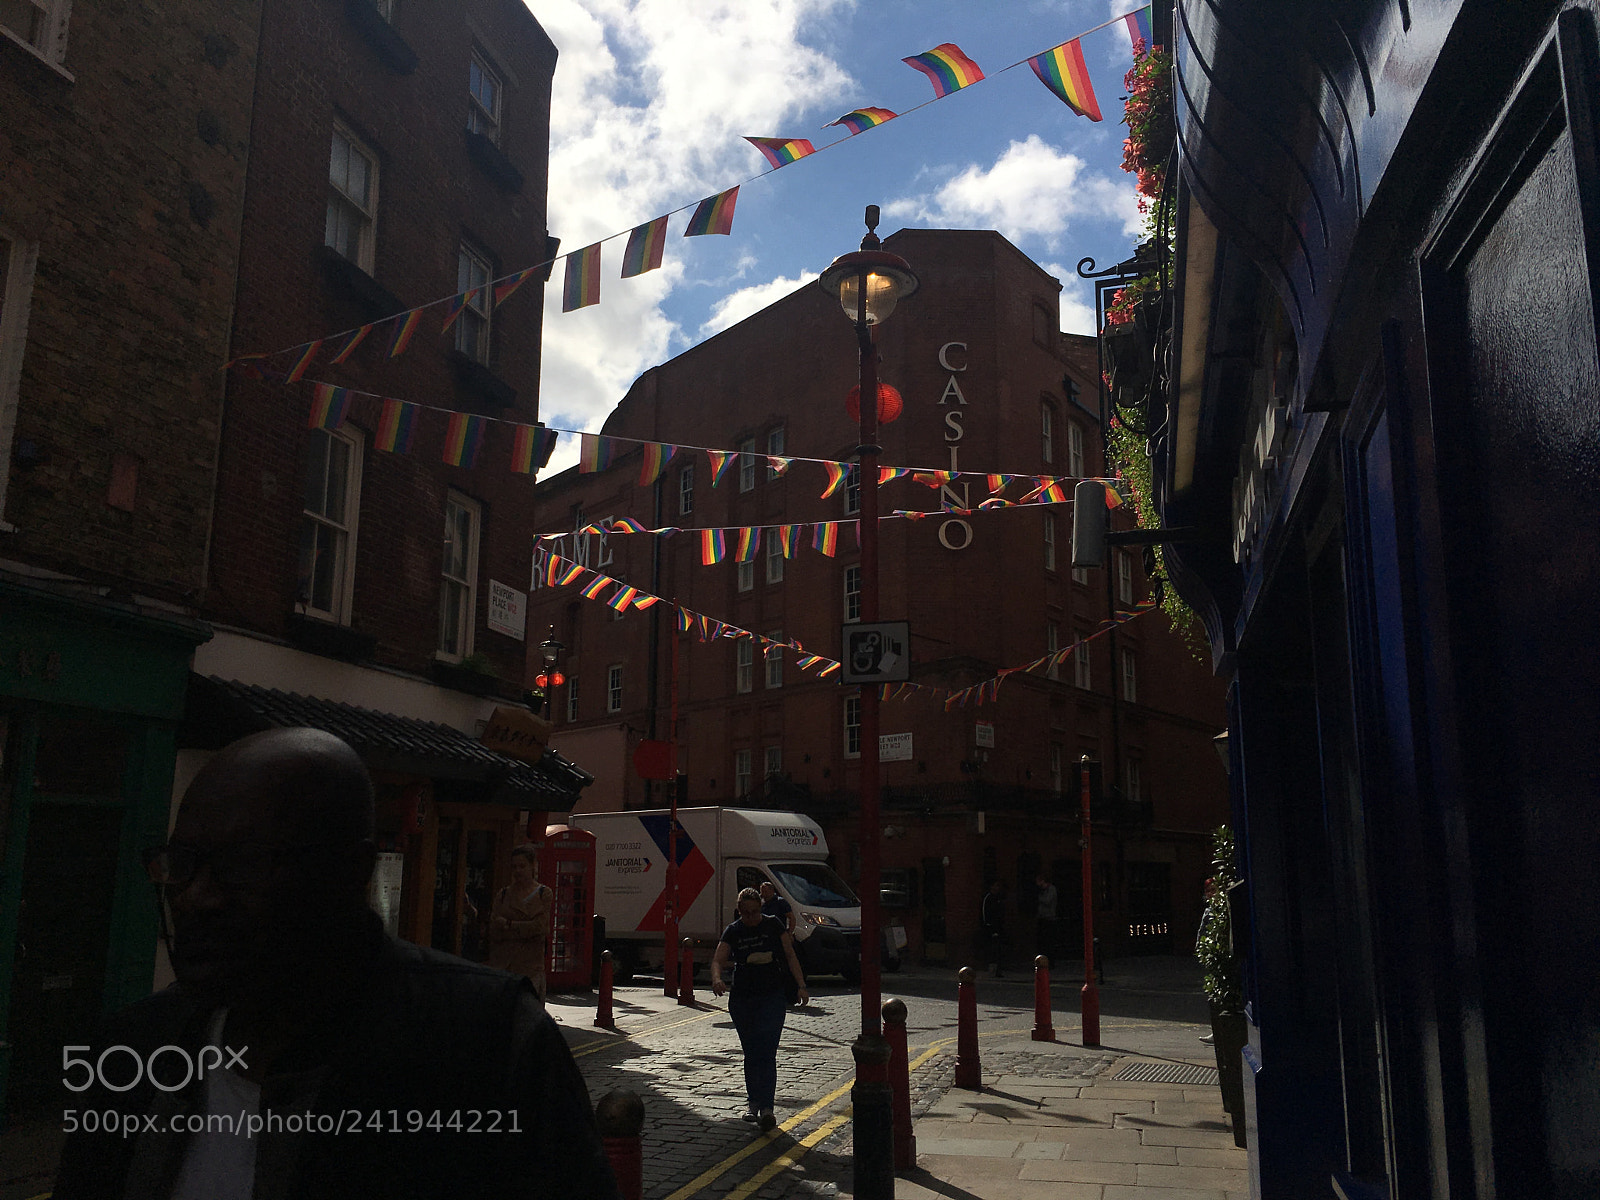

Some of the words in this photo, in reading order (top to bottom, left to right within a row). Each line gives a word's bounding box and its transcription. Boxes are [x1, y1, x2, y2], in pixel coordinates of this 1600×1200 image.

[937, 341, 973, 550] CASINO
[770, 827, 809, 838] JANITORIAL
[605, 857, 642, 867] JANITORIAL
